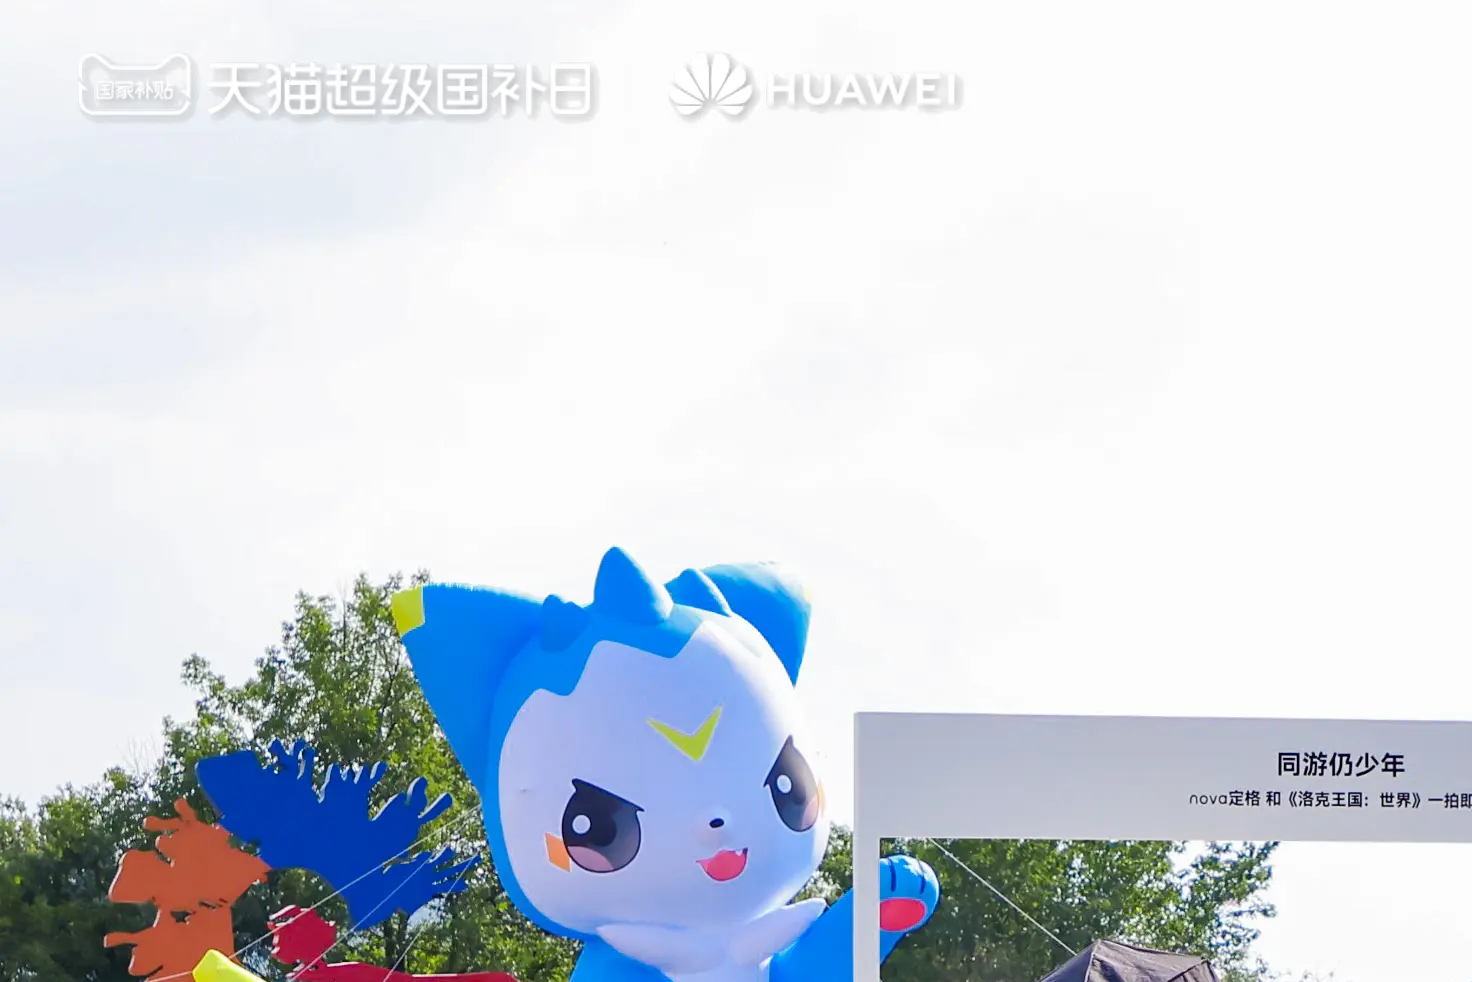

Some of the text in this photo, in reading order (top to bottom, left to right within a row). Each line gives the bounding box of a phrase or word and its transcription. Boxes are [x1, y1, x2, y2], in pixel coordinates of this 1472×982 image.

[1277, 751, 1406, 778] 同游仍少年
[1189, 790, 1262, 807] nova定格
